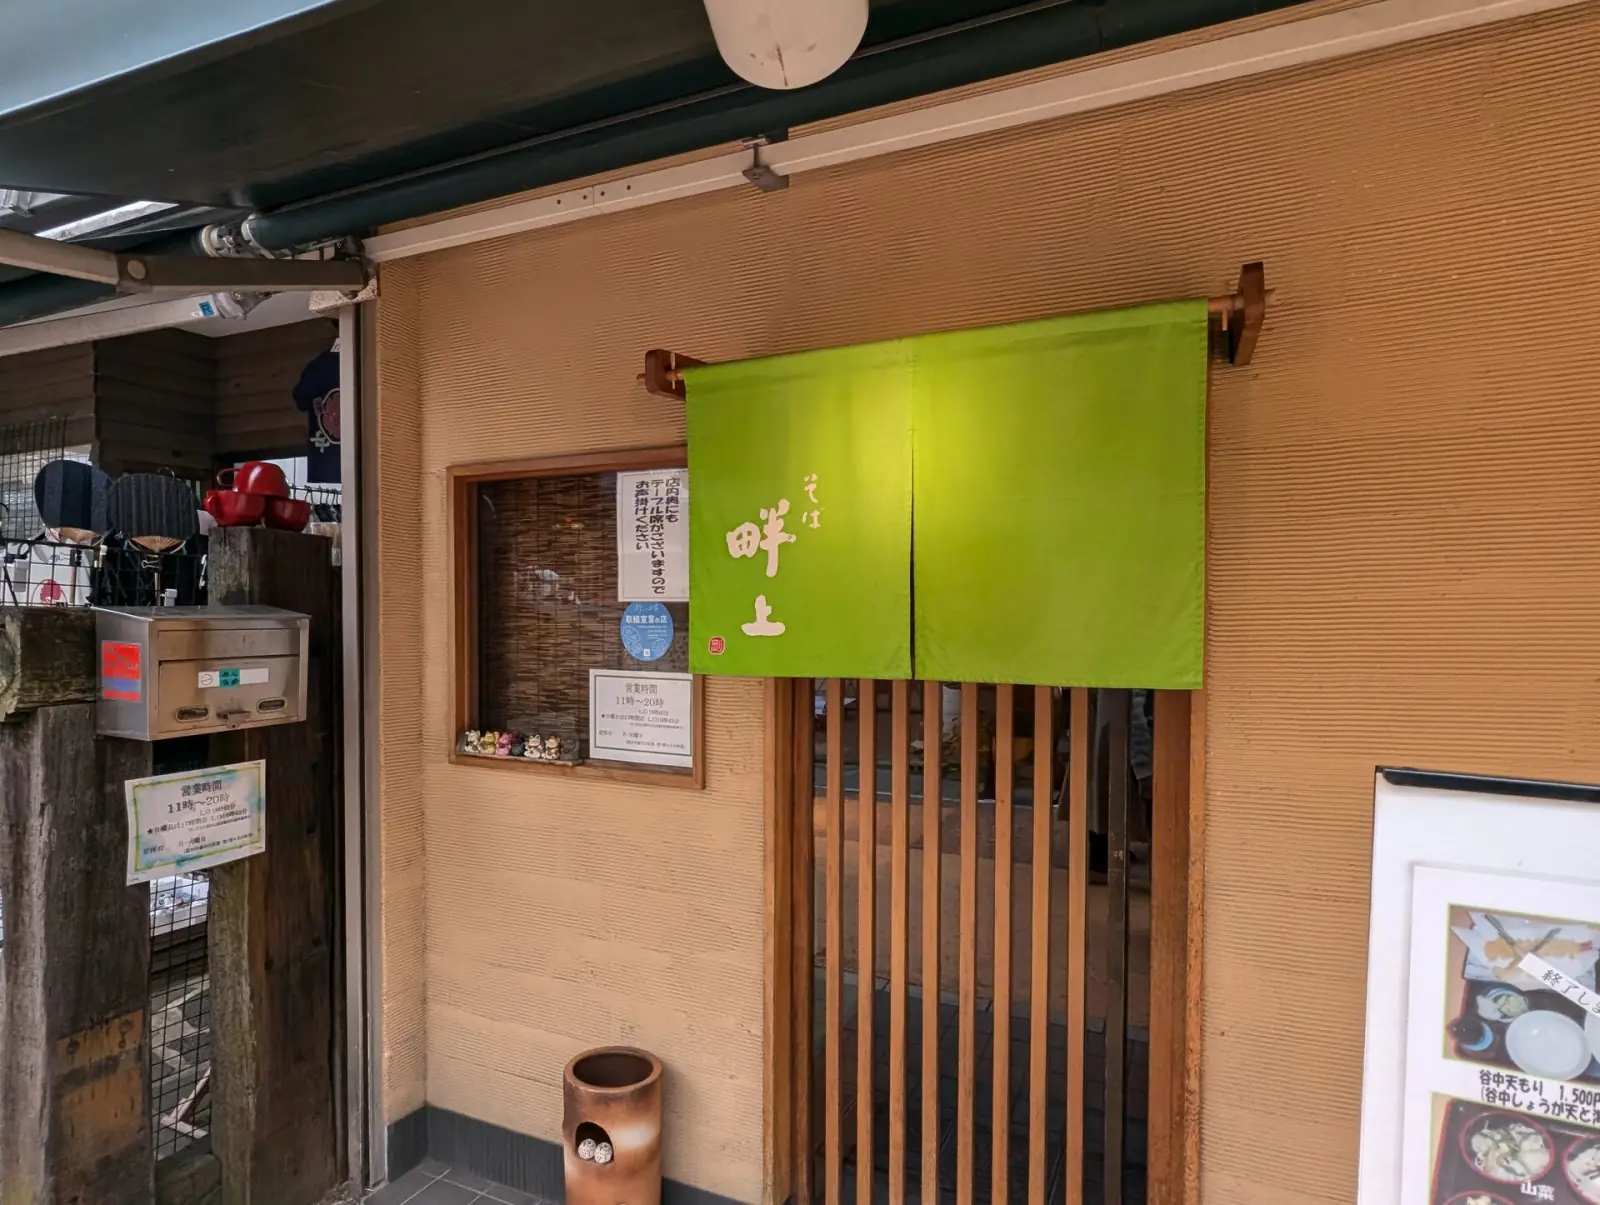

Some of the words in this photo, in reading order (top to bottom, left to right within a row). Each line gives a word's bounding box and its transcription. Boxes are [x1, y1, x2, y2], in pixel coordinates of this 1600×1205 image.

[634, 480, 650, 551] お声掛けください
[665, 477, 680, 523] 店内奥にも
[801, 473, 826, 529] そば
[649, 479, 666, 595] テーブル席がございますので
[725, 498, 797, 637] 畔上
[626, 683, 658, 695] 営業時間
[180, 779, 222, 797] 営業時間
[1479, 1069, 1543, 1097] 谷中天もり
[1520, 1179, 1555, 1202] 山菜
